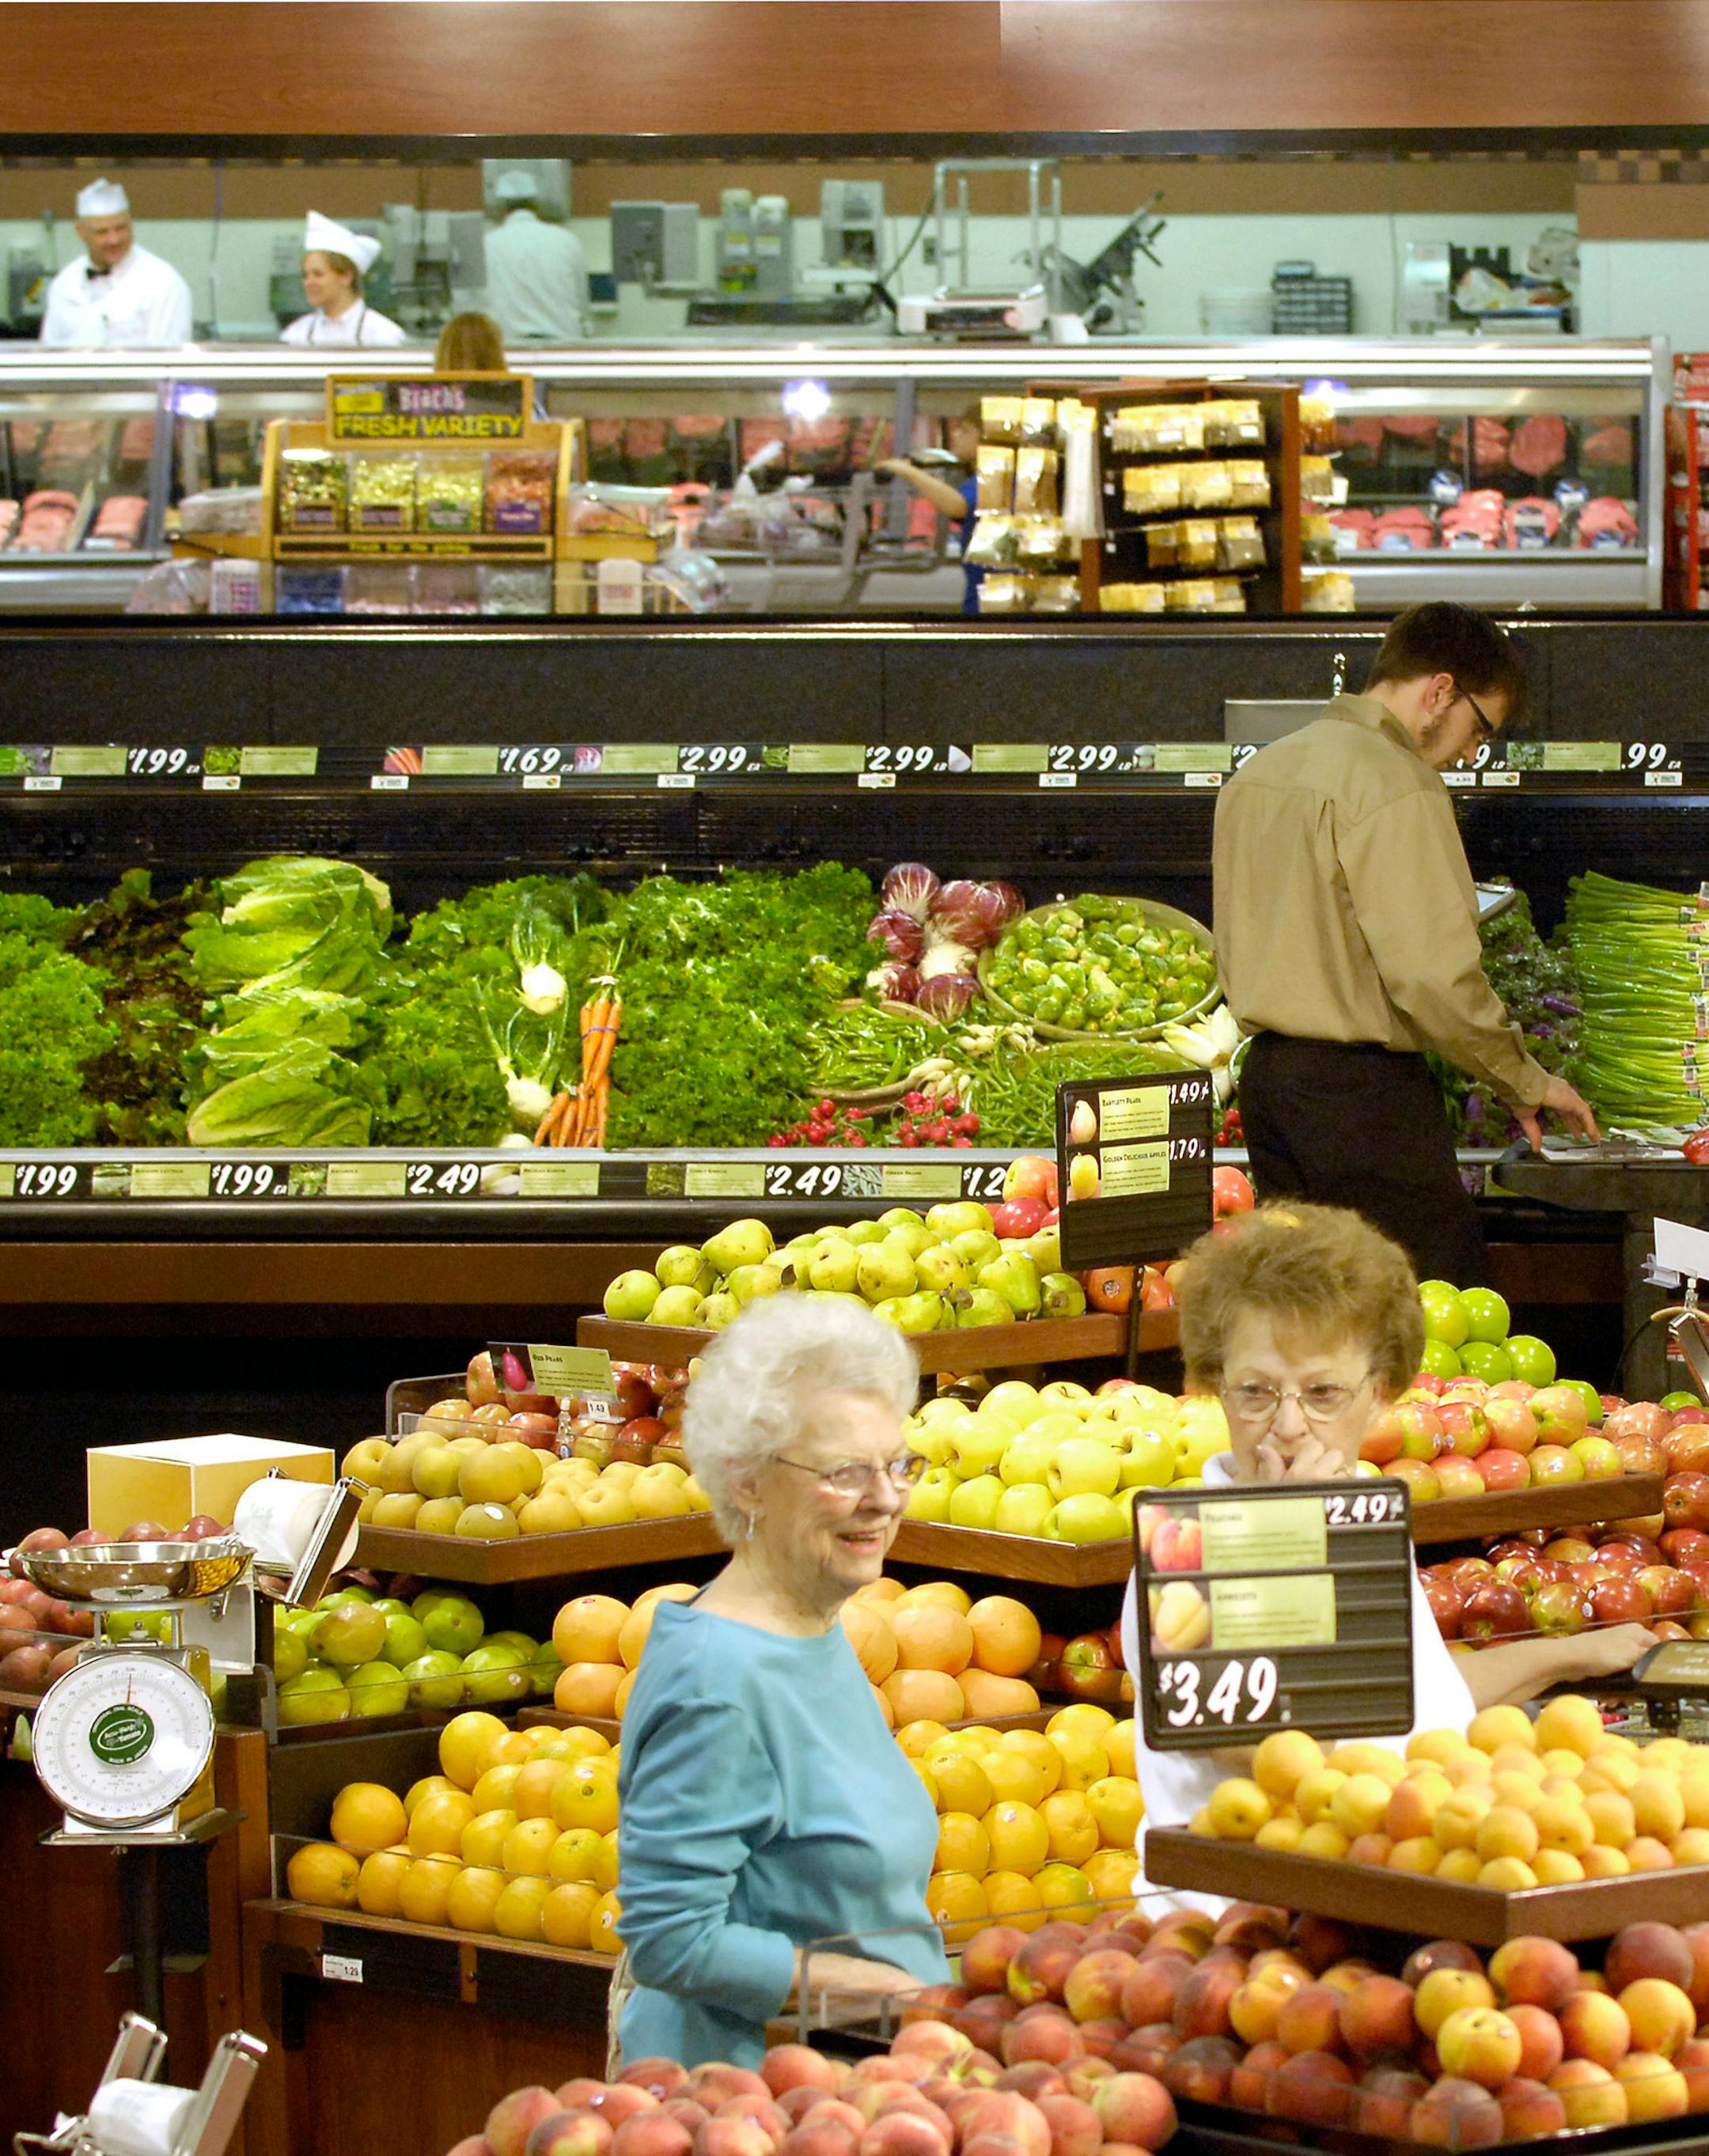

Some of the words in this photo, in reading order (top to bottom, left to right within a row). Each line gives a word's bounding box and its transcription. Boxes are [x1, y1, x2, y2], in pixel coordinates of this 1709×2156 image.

[336, 415, 419, 437] FRESH
[420, 414, 523, 437] VARIETY
[680, 747, 747, 771] $2.99
[866, 747, 934, 771] $2.99
[1049, 745, 1117, 770] $2.99
[16, 1165, 77, 1195] $1.99
[212, 1165, 273, 1195] $1.99
[407, 1164, 479, 1195] $2.49
[766, 1165, 842, 1195] $2.49
[1159, 1657, 1277, 1726] $3.49
